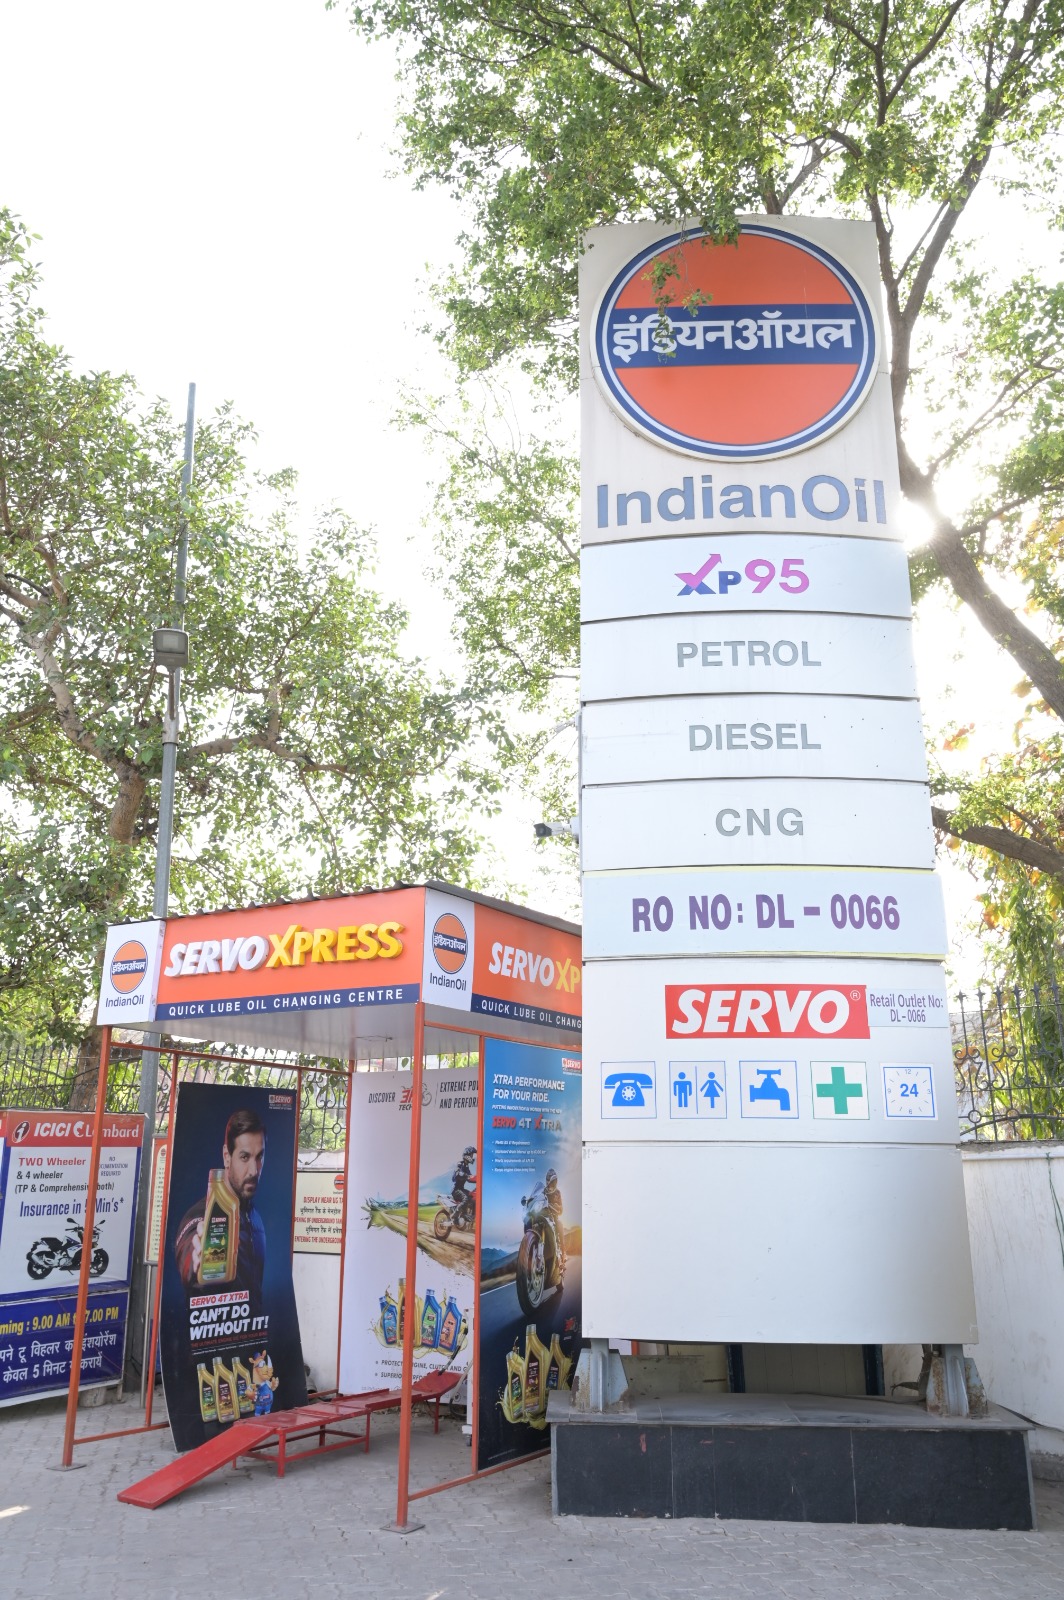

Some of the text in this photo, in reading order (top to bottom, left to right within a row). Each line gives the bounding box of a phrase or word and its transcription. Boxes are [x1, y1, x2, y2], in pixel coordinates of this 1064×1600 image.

[612, 310, 856, 363] इंडियनऑयल
[597, 474, 887, 528] IndianOil
[677, 640, 821, 667] PETROL
[688, 723, 821, 751] DIESEL
[715, 807, 804, 836] CNG
[632, 896, 674, 932] RO
[689, 894, 744, 931] NO:
[831, 894, 900, 930] 0066
[489, 942, 582, 993] SERVOXP
[430, 973, 467, 991] IndianOil
[106, 995, 144, 1007] IndianOil
[169, 989, 403, 1016] QUICK LUBE OIL CHANGING CENTRE
[870, 994, 944, 1008] Retail Outlet No:
[481, 1000, 510, 1014] QUICK
[514, 1007, 536, 1019] LUBE
[540, 1012, 552, 1023] OIL
[672, 989, 849, 1034] SERVO
[440, 1081, 466, 1092] EXTREME
[493, 1074, 566, 1091] XTRA PERFORMANCE
[900, 1083, 919, 1097] 24
[368, 1092, 396, 1103] DISCOVER
[440, 1098, 452, 1109] AND
[493, 1088, 550, 1102] FOR YOUR RIDE.
[34, 1122, 139, 1138] ICICI Lmbard
[492, 1114, 562, 1131] SERVO 4T XTRA
[18, 1157, 86, 1167] TWO Wheeler
[16, 1171, 63, 1180] & 4 wheeler
[15, 1184, 28, 1194] (TP
[30, 1184, 37, 1192] &
[20, 1201, 69, 1217] Insurance
[72, 1198, 81, 1214] in
[191, 1292, 249, 1307] SERVO 4T XTRA
[32, 1315, 53, 1330] 9.00
[55, 1313, 71, 1328] AM
[105, 1306, 119, 1321] PM
[190, 1303, 250, 1325] CAN'T DO
[190, 1315, 269, 1340] WITHOUT IT!
[19, 1346, 27, 1363] टू
[31, 1340, 60, 1358] विहलर
[3, 1366, 28, 1383] केवल
[33, 1364, 40, 1379] 5
[43, 1360, 67, 1377] मिनट
